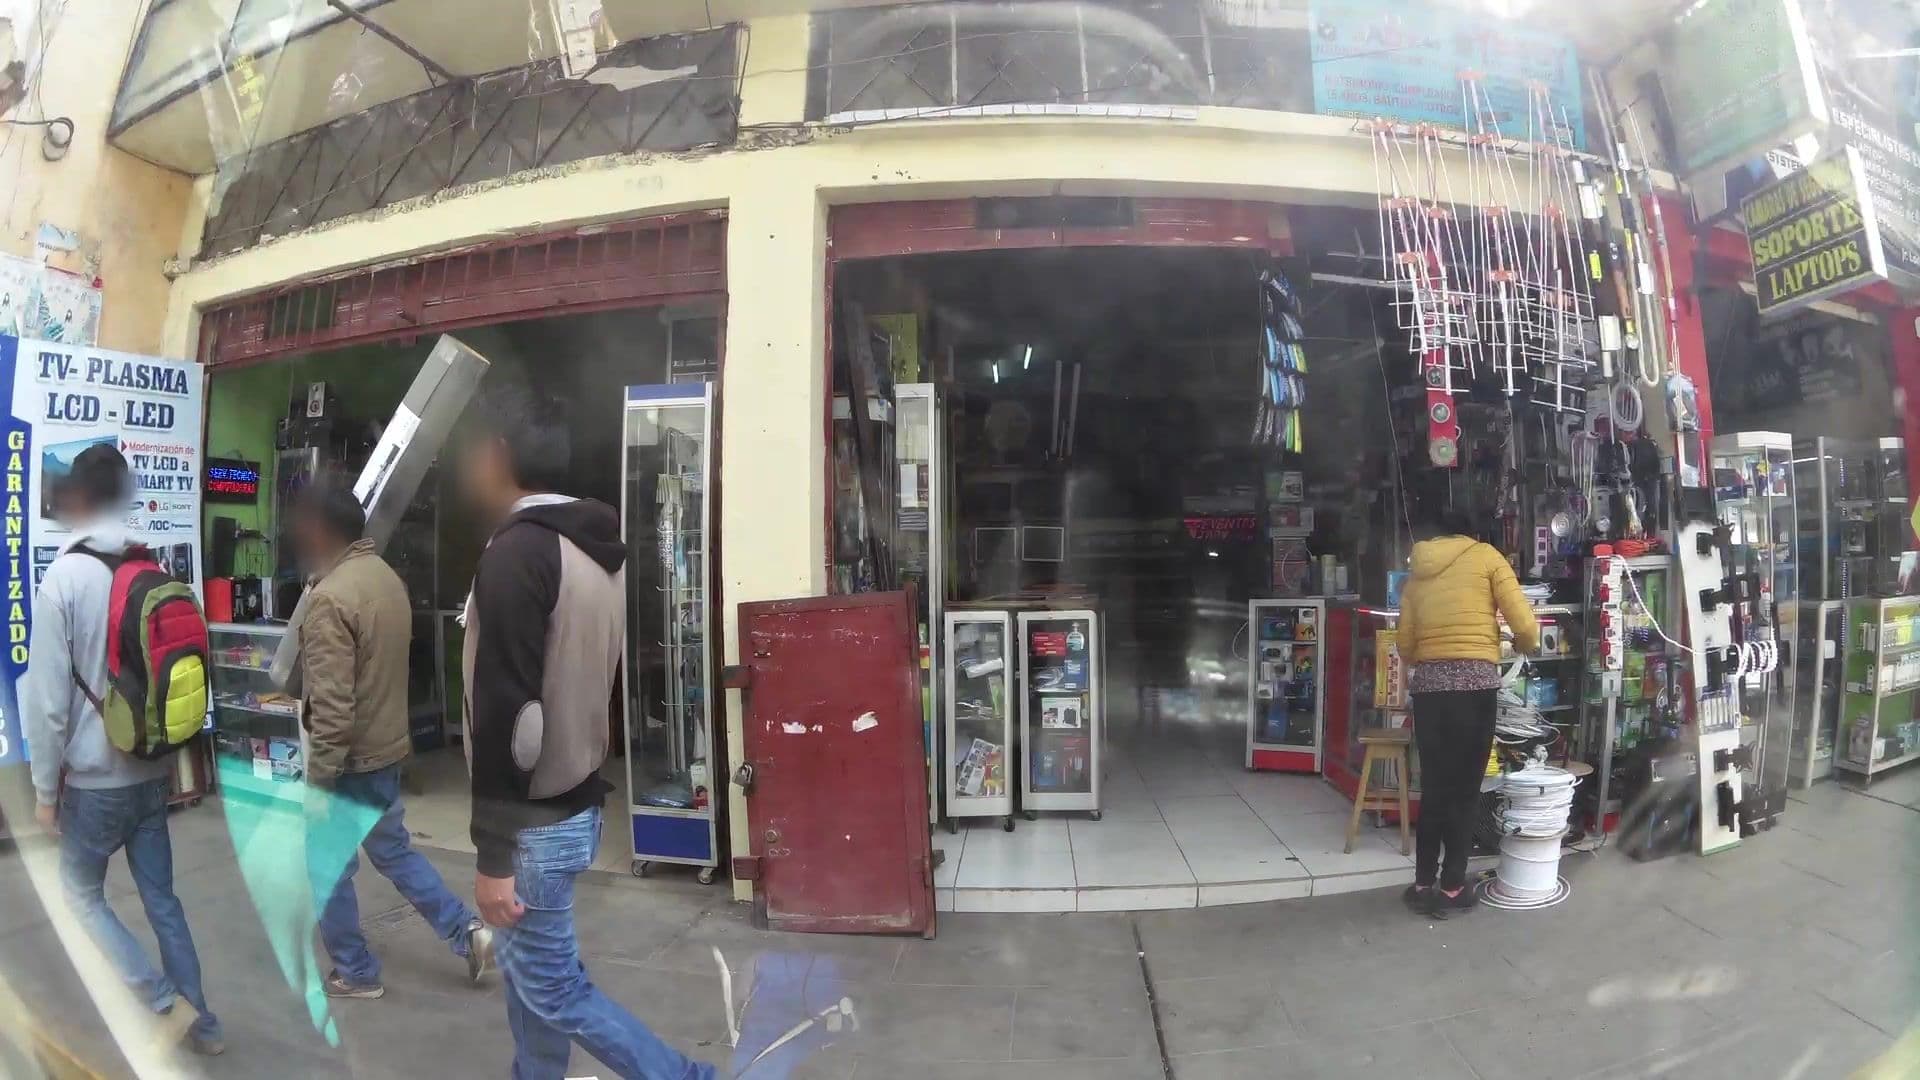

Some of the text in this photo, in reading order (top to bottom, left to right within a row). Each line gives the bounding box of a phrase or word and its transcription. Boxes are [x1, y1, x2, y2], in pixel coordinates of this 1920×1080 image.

[1769, 240, 1862, 301] LAPTOPS
[38, 351, 78, 381] TV-
[85, 357, 189, 395] PLASMA
[46, 392, 101, 422] LCD
[124, 400, 175, 430] LED
[129, 441, 195, 455] Modernización de
[132, 454, 190, 472] TV LCD a
[134, 474, 194, 491] MART TV
[148, 519, 170, 531] AOC
[5, 431, 28, 664] GARANTIZADO
